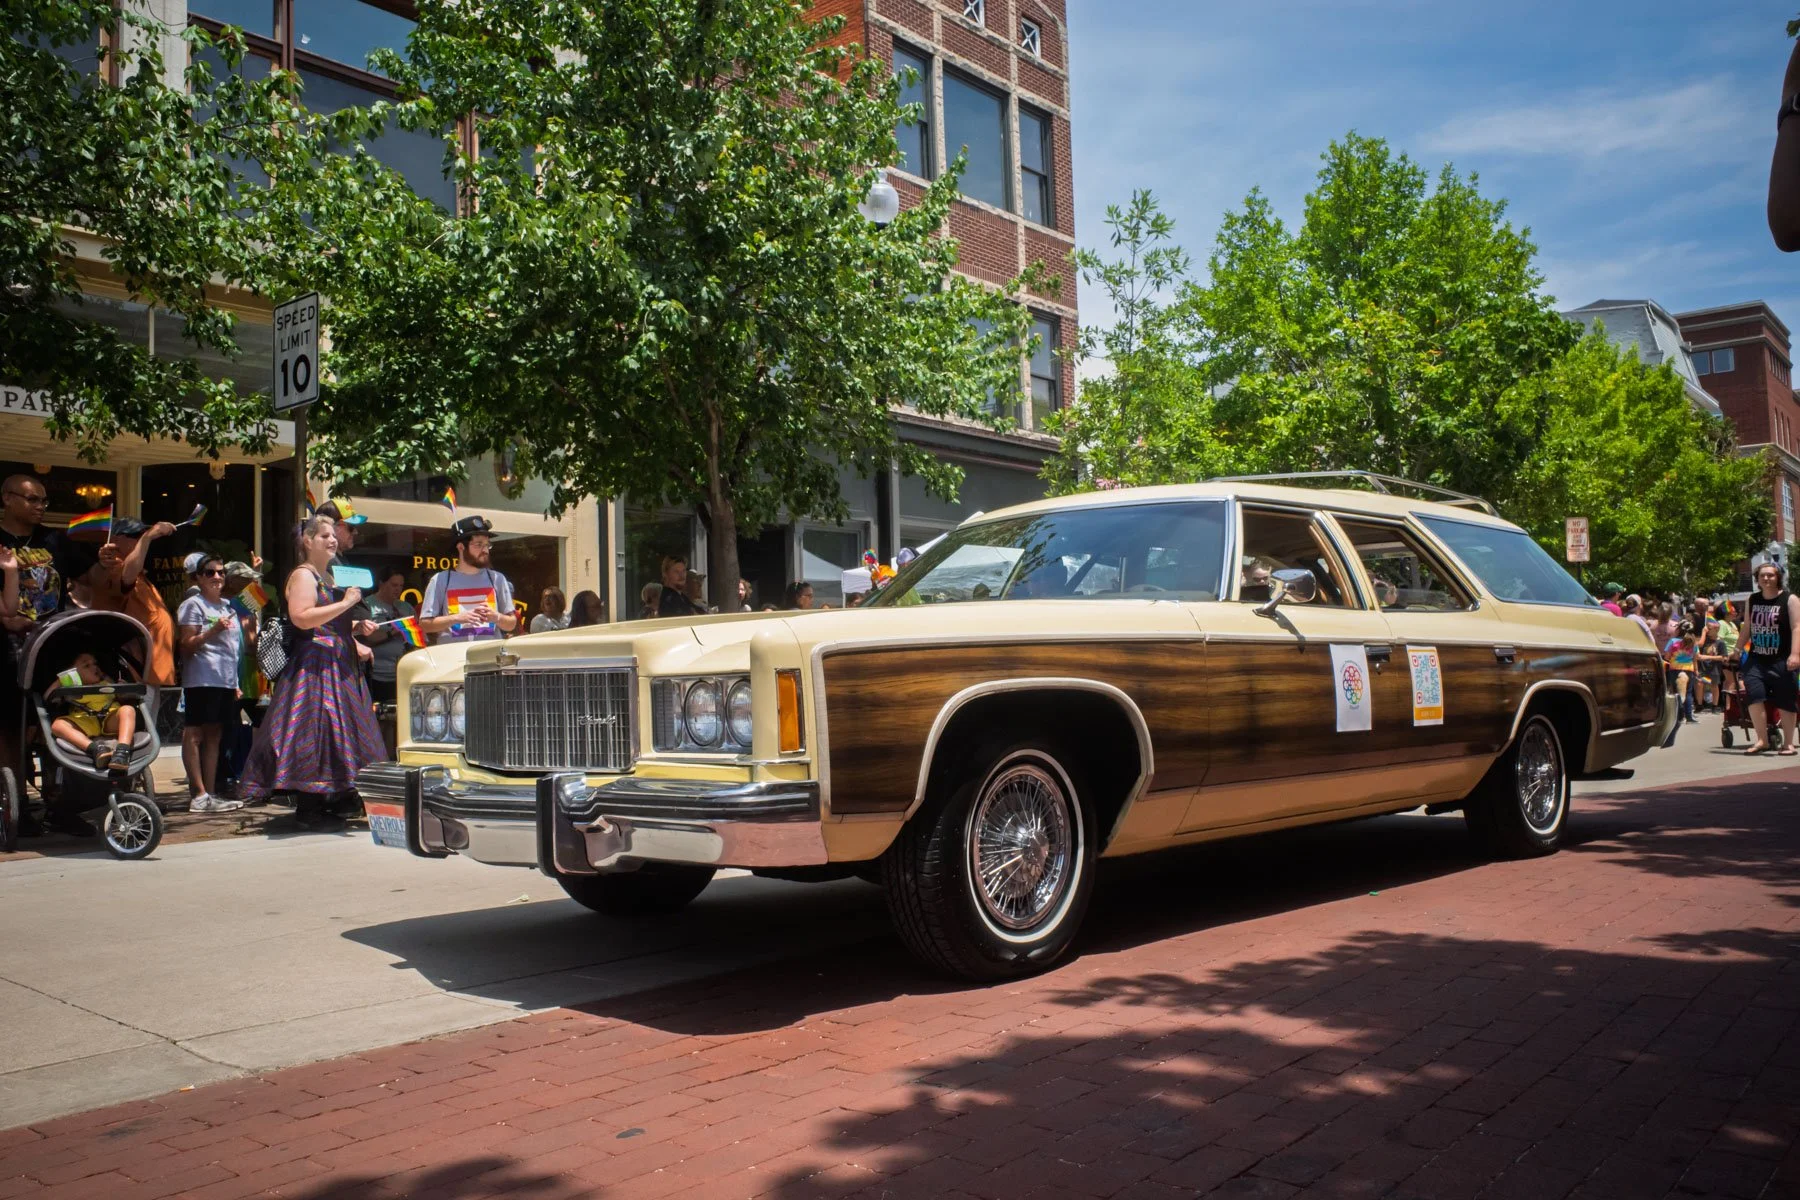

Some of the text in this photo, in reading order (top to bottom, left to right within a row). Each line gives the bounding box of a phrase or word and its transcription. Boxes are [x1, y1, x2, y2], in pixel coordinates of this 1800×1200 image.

[276, 305, 315, 331] SPEED
[280, 329, 311, 352] LIMIT
[280, 353, 311, 397] 10
[1751, 612, 1779, 627] LOVE
[1752, 605, 1780, 613] DIVERSITY
